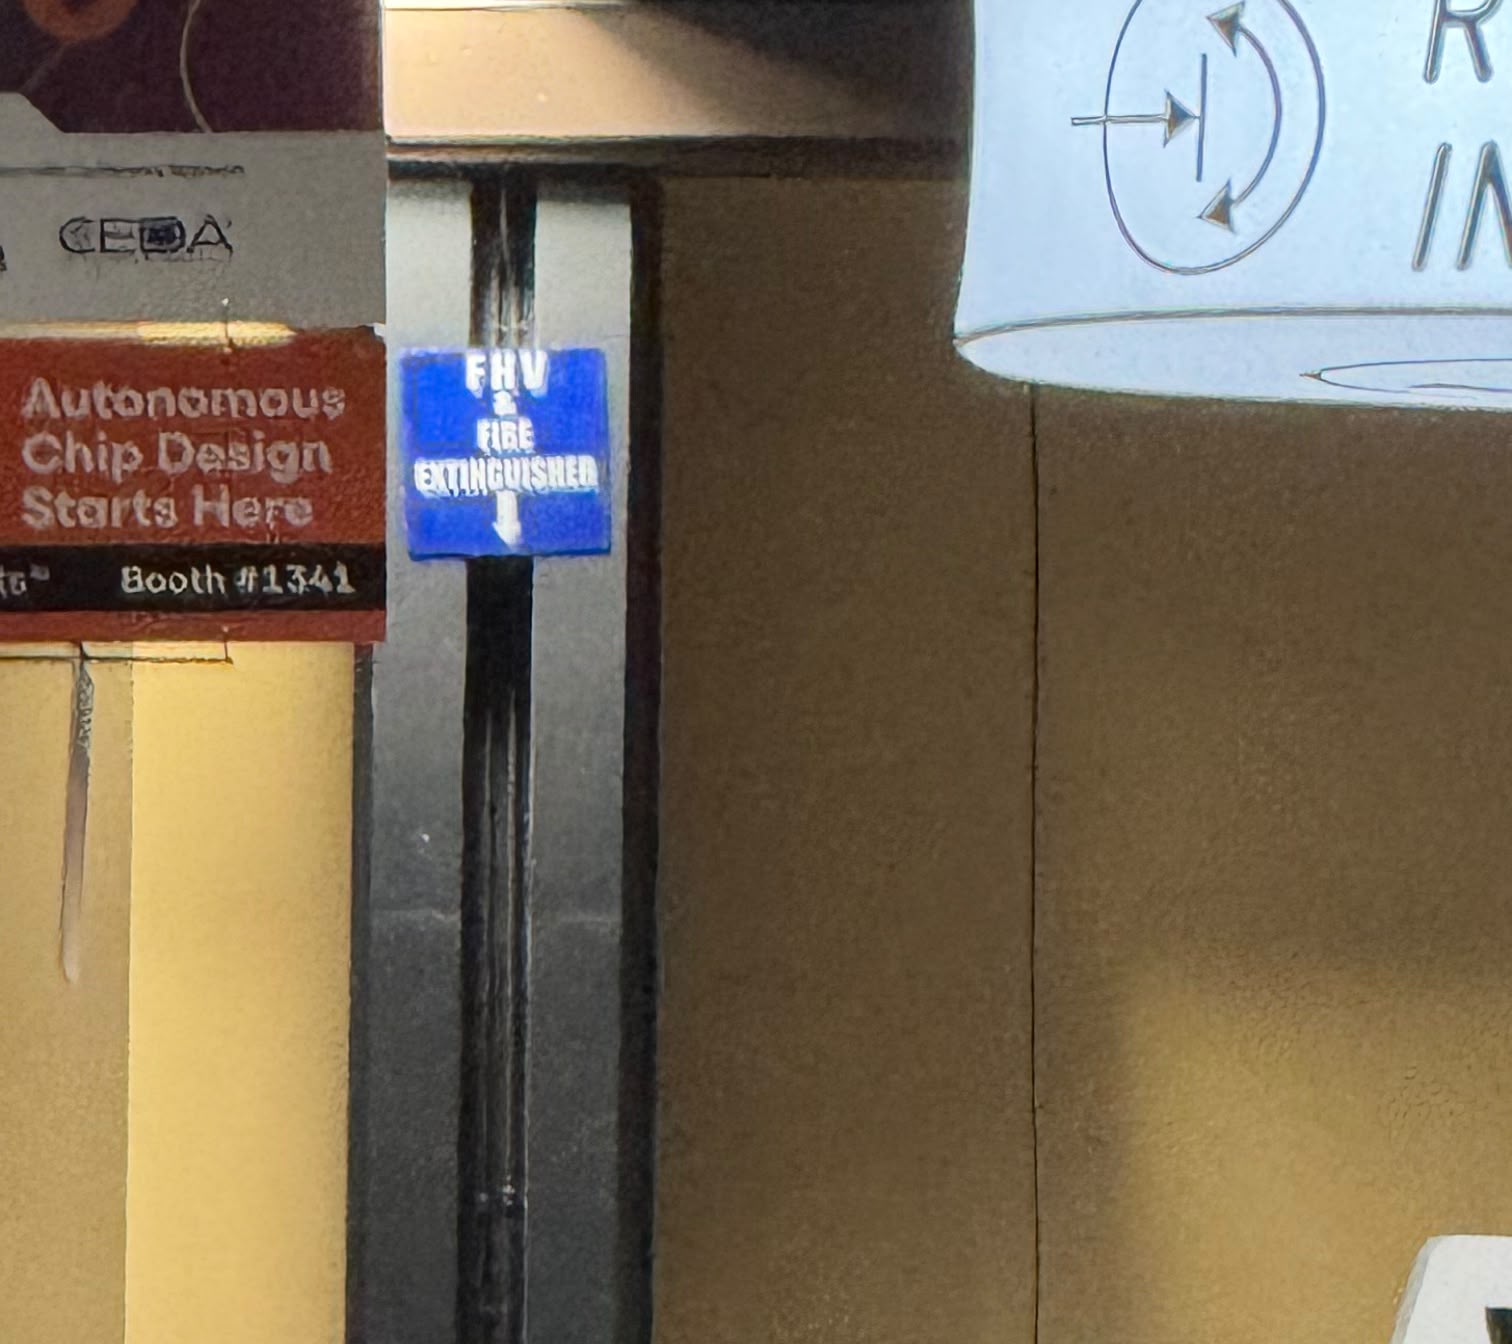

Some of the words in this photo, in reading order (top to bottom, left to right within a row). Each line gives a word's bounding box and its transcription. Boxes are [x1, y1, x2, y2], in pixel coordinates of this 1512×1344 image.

[465, 347, 549, 397] FHV
[21, 376, 347, 421] Autonomous
[21, 431, 145, 483] Chip
[157, 430, 333, 485] Design
[476, 417, 536, 453] FIRE
[413, 454, 600, 497] EXTINGUISHER
[21, 485, 179, 531] Starts
[191, 483, 314, 529] Here
[120, 564, 226, 596] Booth
[235, 560, 356, 596] #1341
